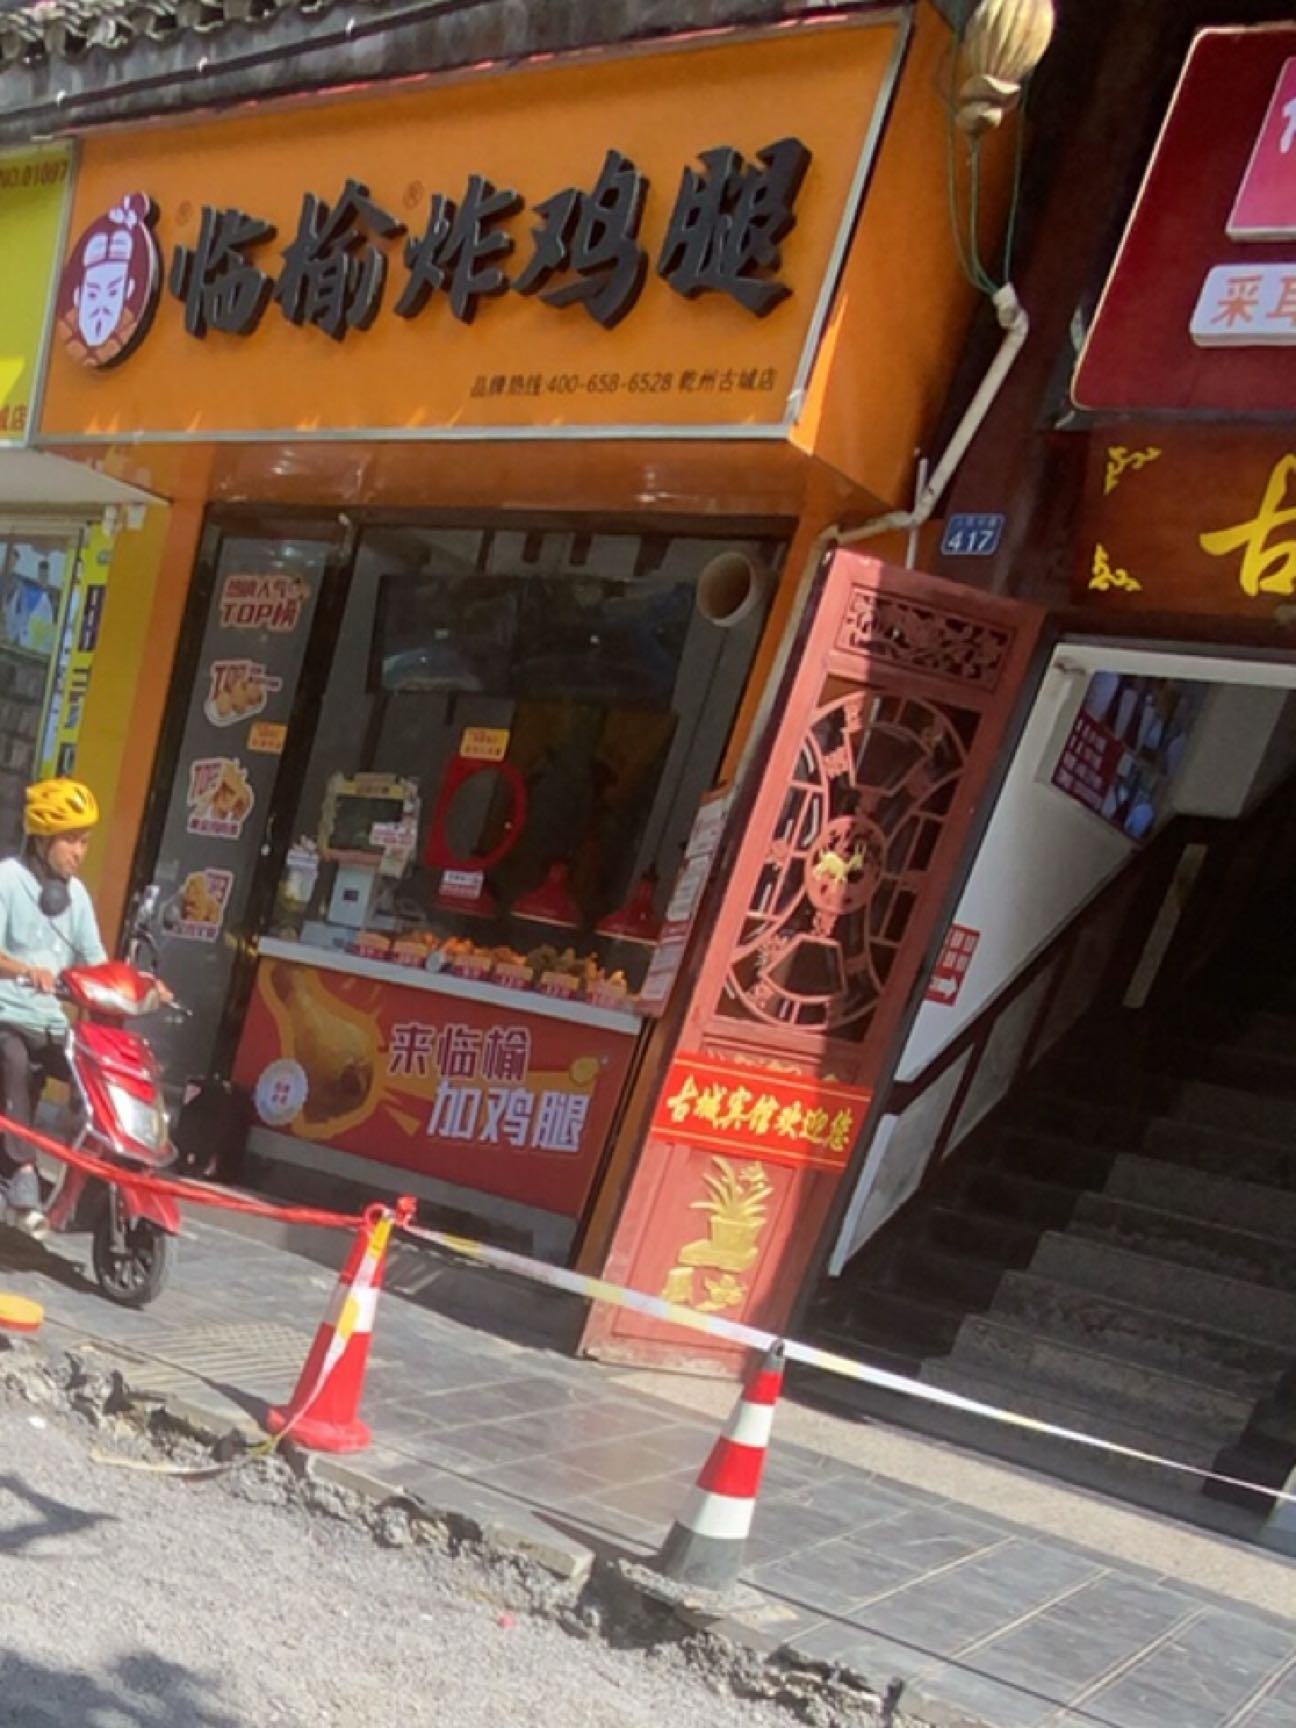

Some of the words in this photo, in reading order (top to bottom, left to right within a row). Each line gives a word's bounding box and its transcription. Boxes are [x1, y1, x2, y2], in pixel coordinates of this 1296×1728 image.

[170, 137, 813, 342] 临榆炸鸡腿
[948, 530, 994, 553] 417
[389, 1025, 528, 1080] 来临榆
[426, 1080, 591, 1153] 加鸡腿
[667, 1072, 854, 1153] 古城宾馆欢迎您
